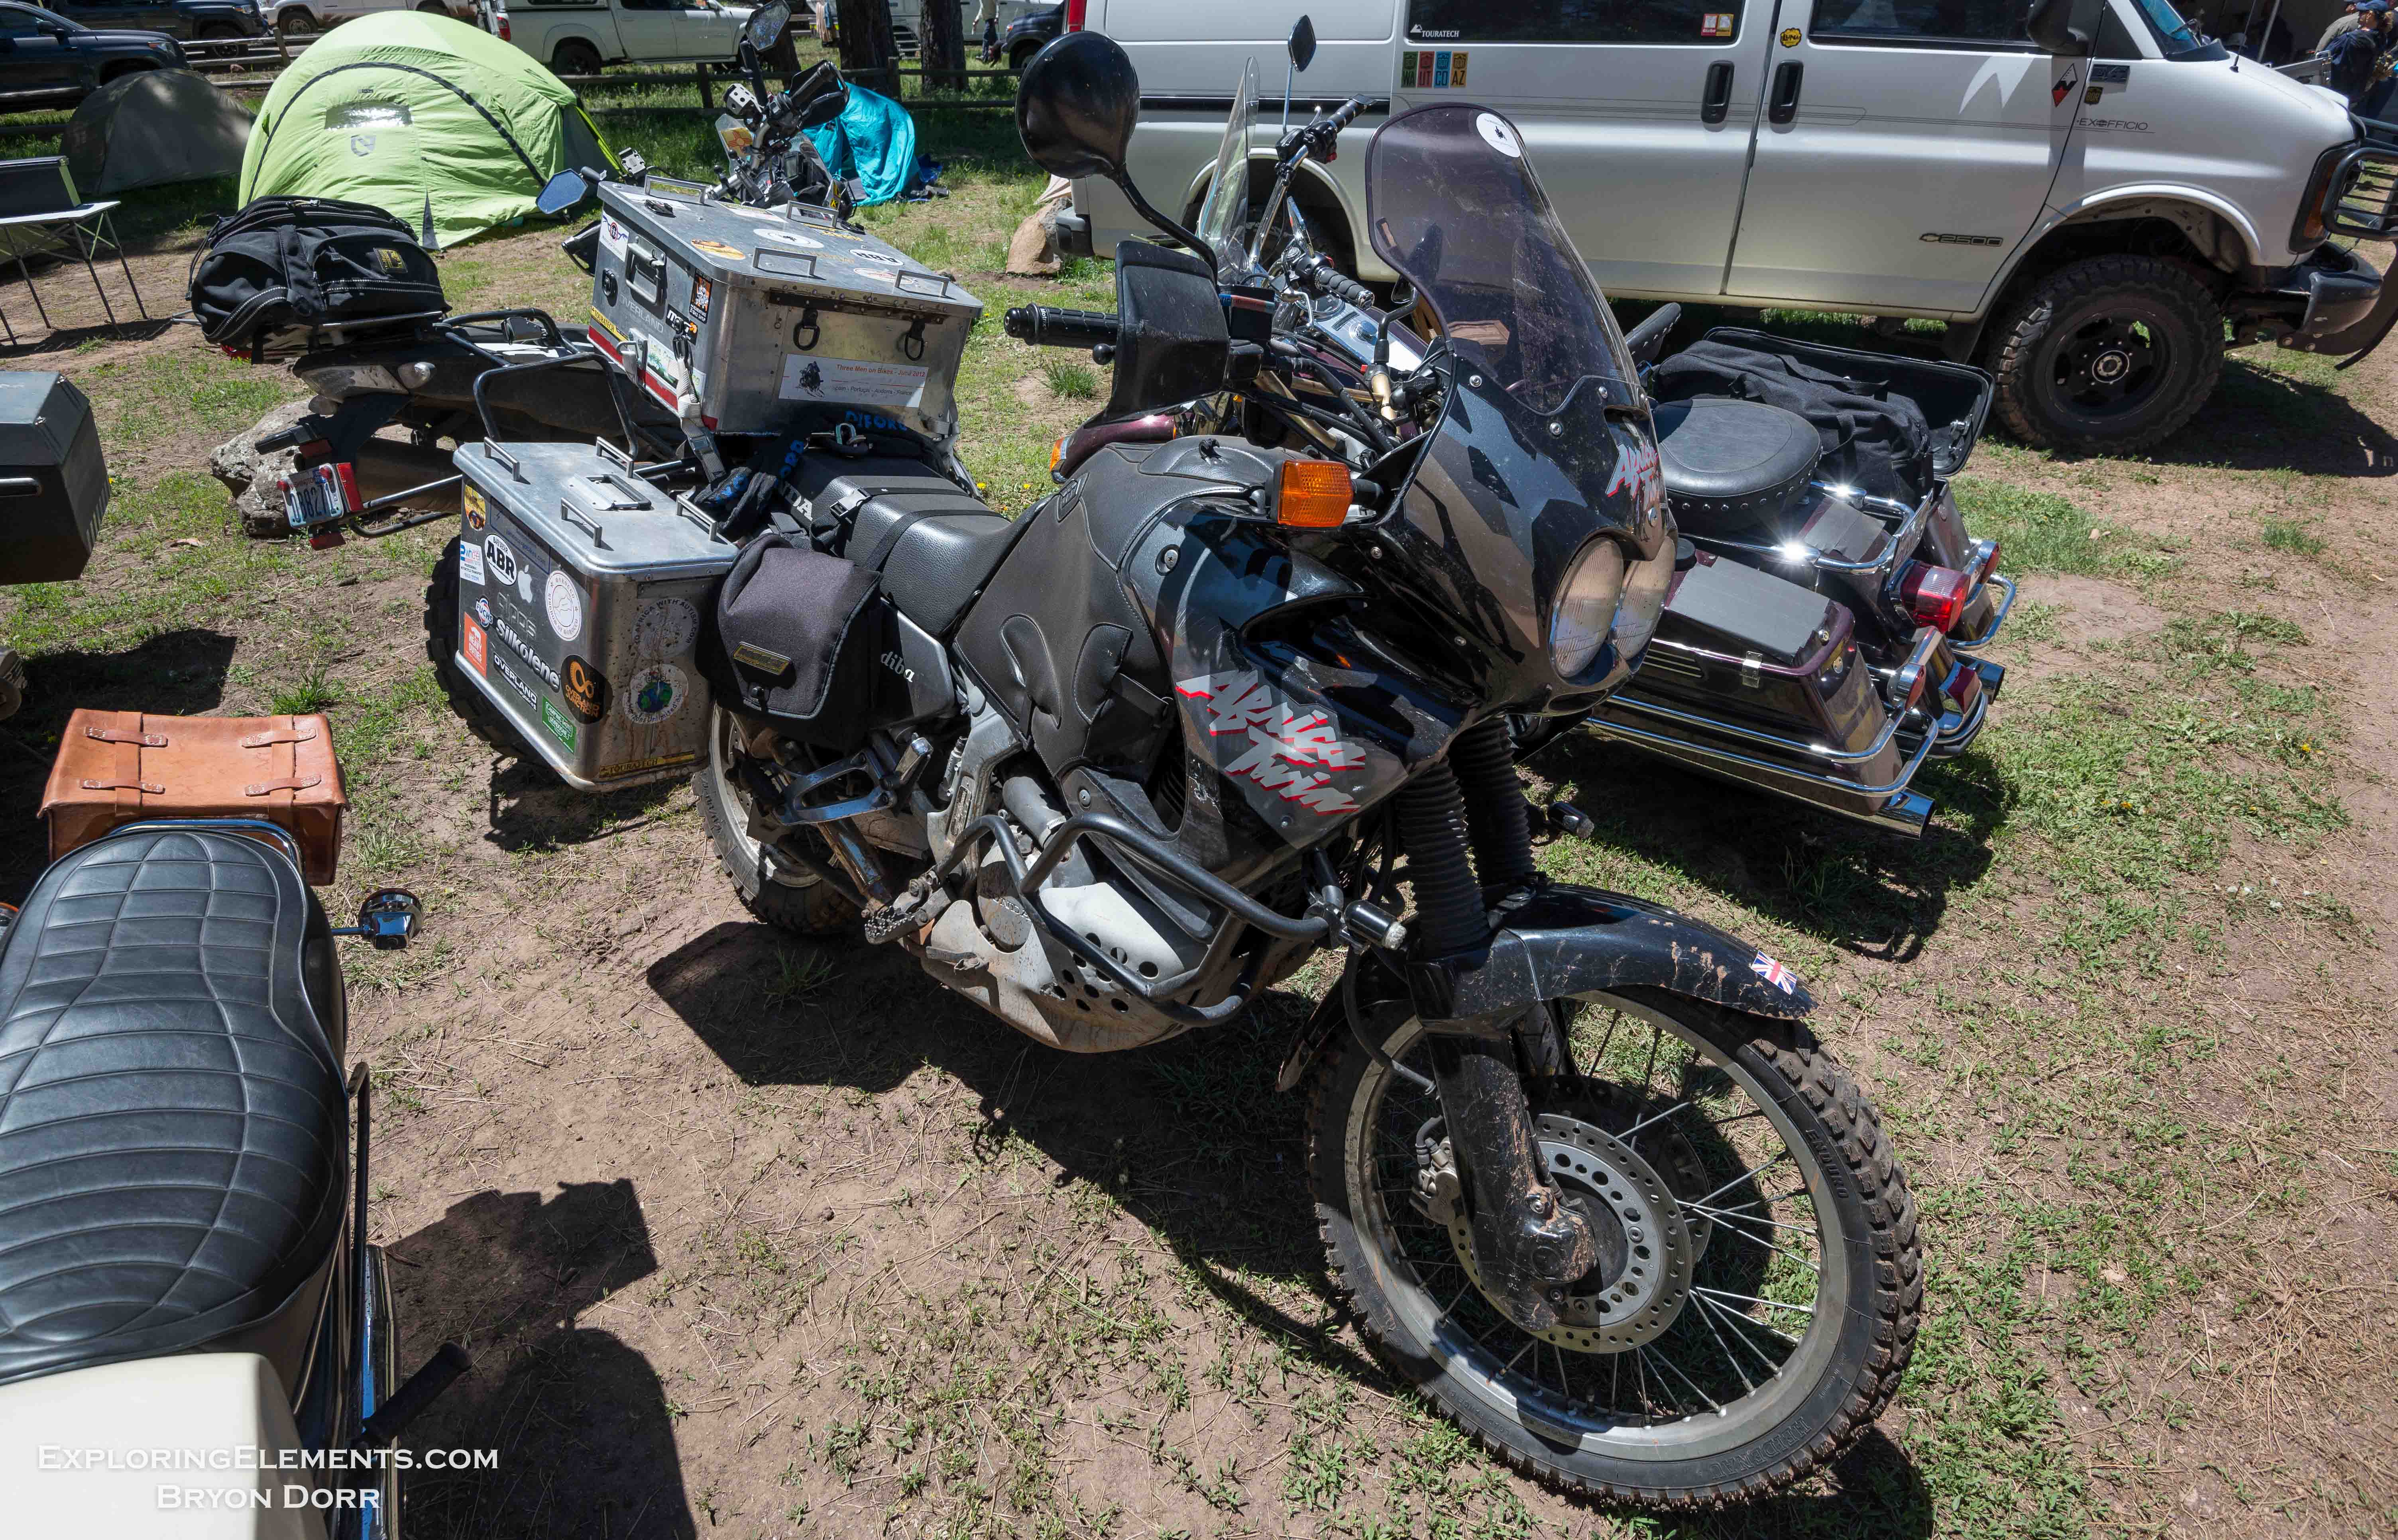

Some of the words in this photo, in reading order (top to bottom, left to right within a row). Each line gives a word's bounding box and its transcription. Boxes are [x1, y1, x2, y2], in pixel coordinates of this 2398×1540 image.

[1402, 70, 1415, 86] WA
[1419, 70, 1431, 85] UT
[1435, 70, 1449, 86] CO
[1451, 70, 1466, 85] AZ
[1939, 234, 2003, 247] 2500
[594, 309, 615, 332] TOURATECH
[619, 294, 664, 334] OVERLAND
[486, 540, 515, 580] ABR
[476, 603, 493, 623] FUCHS
[635, 605, 654, 632] AFRICA
[657, 599, 678, 609] WITH
[469, 632, 482, 652] HEAVY
[469, 642, 482, 663] DUTIES
[496, 619, 561, 690] Silkolene
[494, 654, 537, 703] OVERLAND
[565, 685, 600, 711] OVERLAND
[1175, 670, 1366, 772] AFRICA
[609, 758, 658, 774] TOURATECH
[1805, 1129, 1849, 1199] ENDURO
[1710, 1416, 1812, 1480] HEIDENAU
